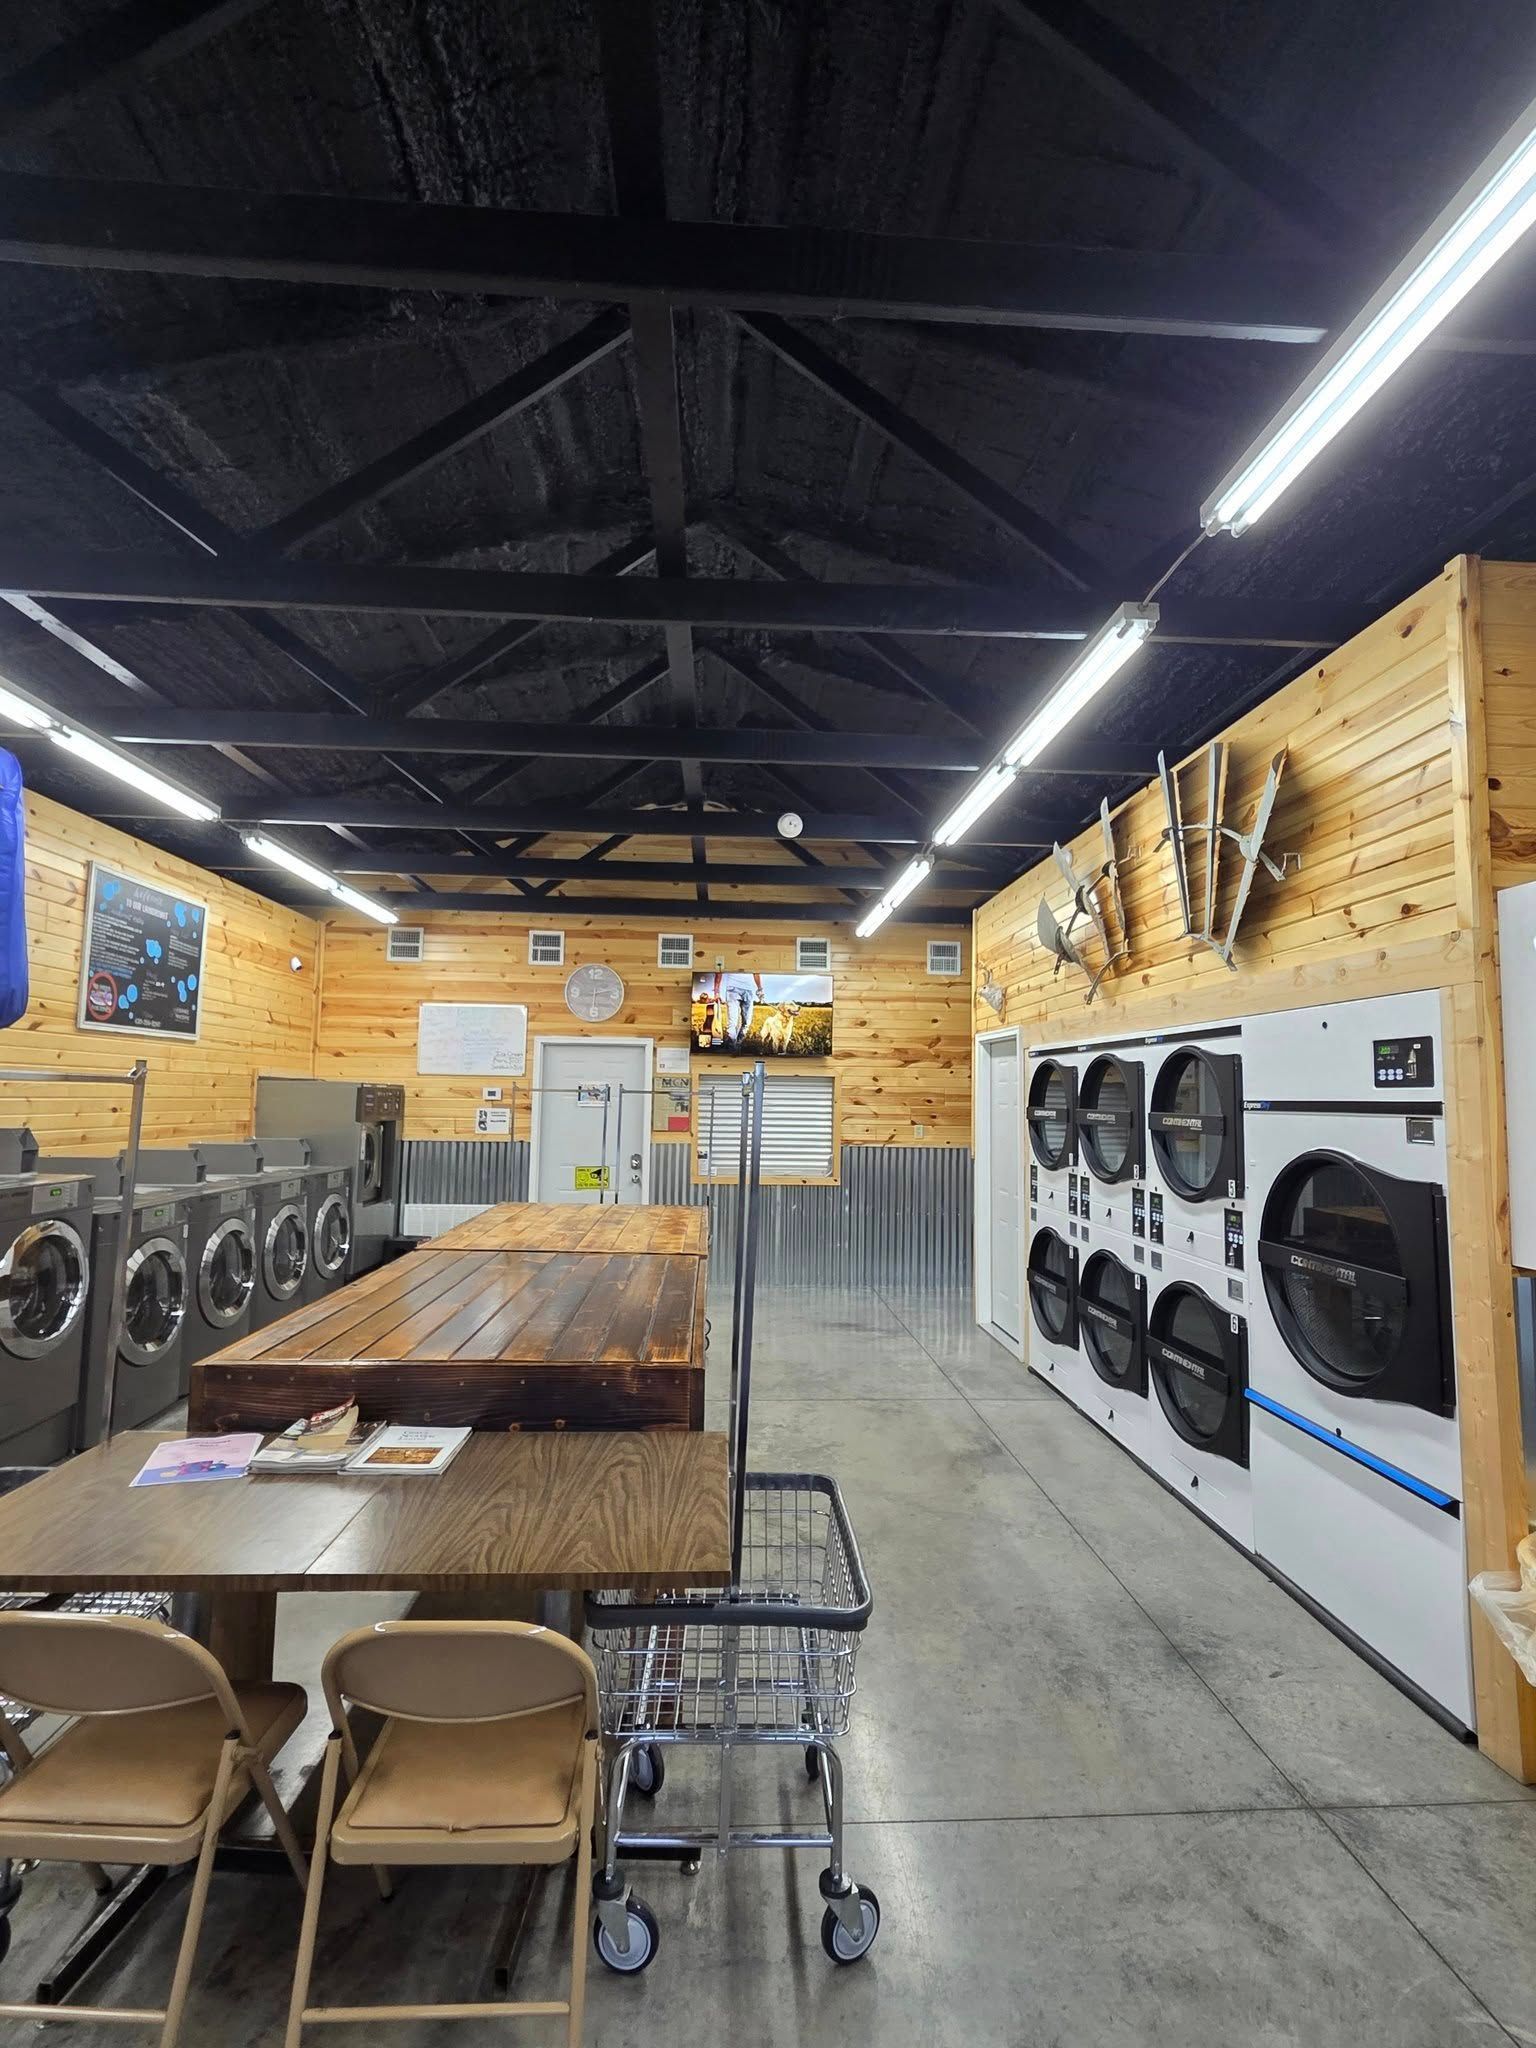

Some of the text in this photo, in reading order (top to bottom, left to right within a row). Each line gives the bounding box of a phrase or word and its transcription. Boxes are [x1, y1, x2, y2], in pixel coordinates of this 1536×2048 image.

[588, 969, 603, 980] 12
[571, 987, 579, 998] 9
[610, 988, 620, 999] 3
[590, 1007, 599, 1018] 6
[1163, 1117, 1202, 1128] CONTINENTAL
[1291, 1255, 1357, 1283] CONTINENTAL
[1162, 1348, 1205, 1377] CONTINENTAL
